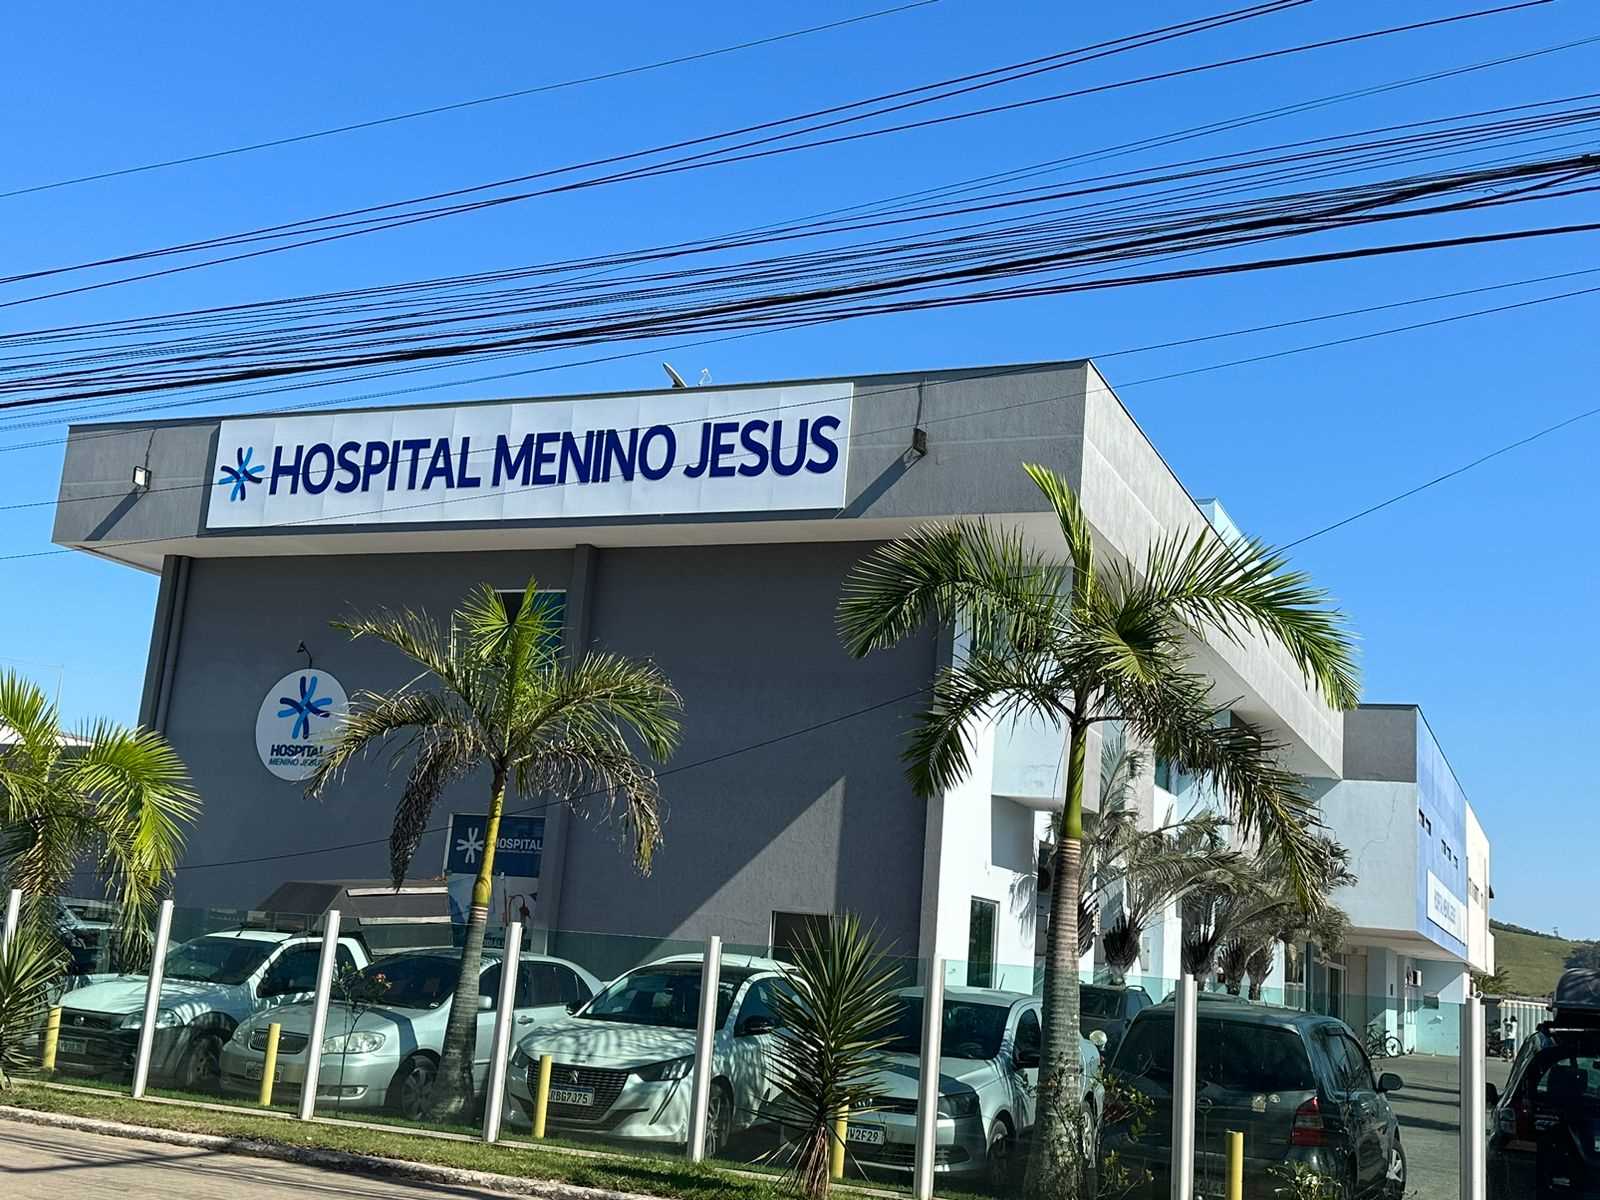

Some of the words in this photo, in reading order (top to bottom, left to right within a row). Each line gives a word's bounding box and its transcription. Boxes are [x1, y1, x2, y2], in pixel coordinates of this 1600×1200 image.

[269, 436, 481, 496] HOSPITAL
[491, 424, 677, 487] MENINO
[683, 415, 841, 478] JESUS
